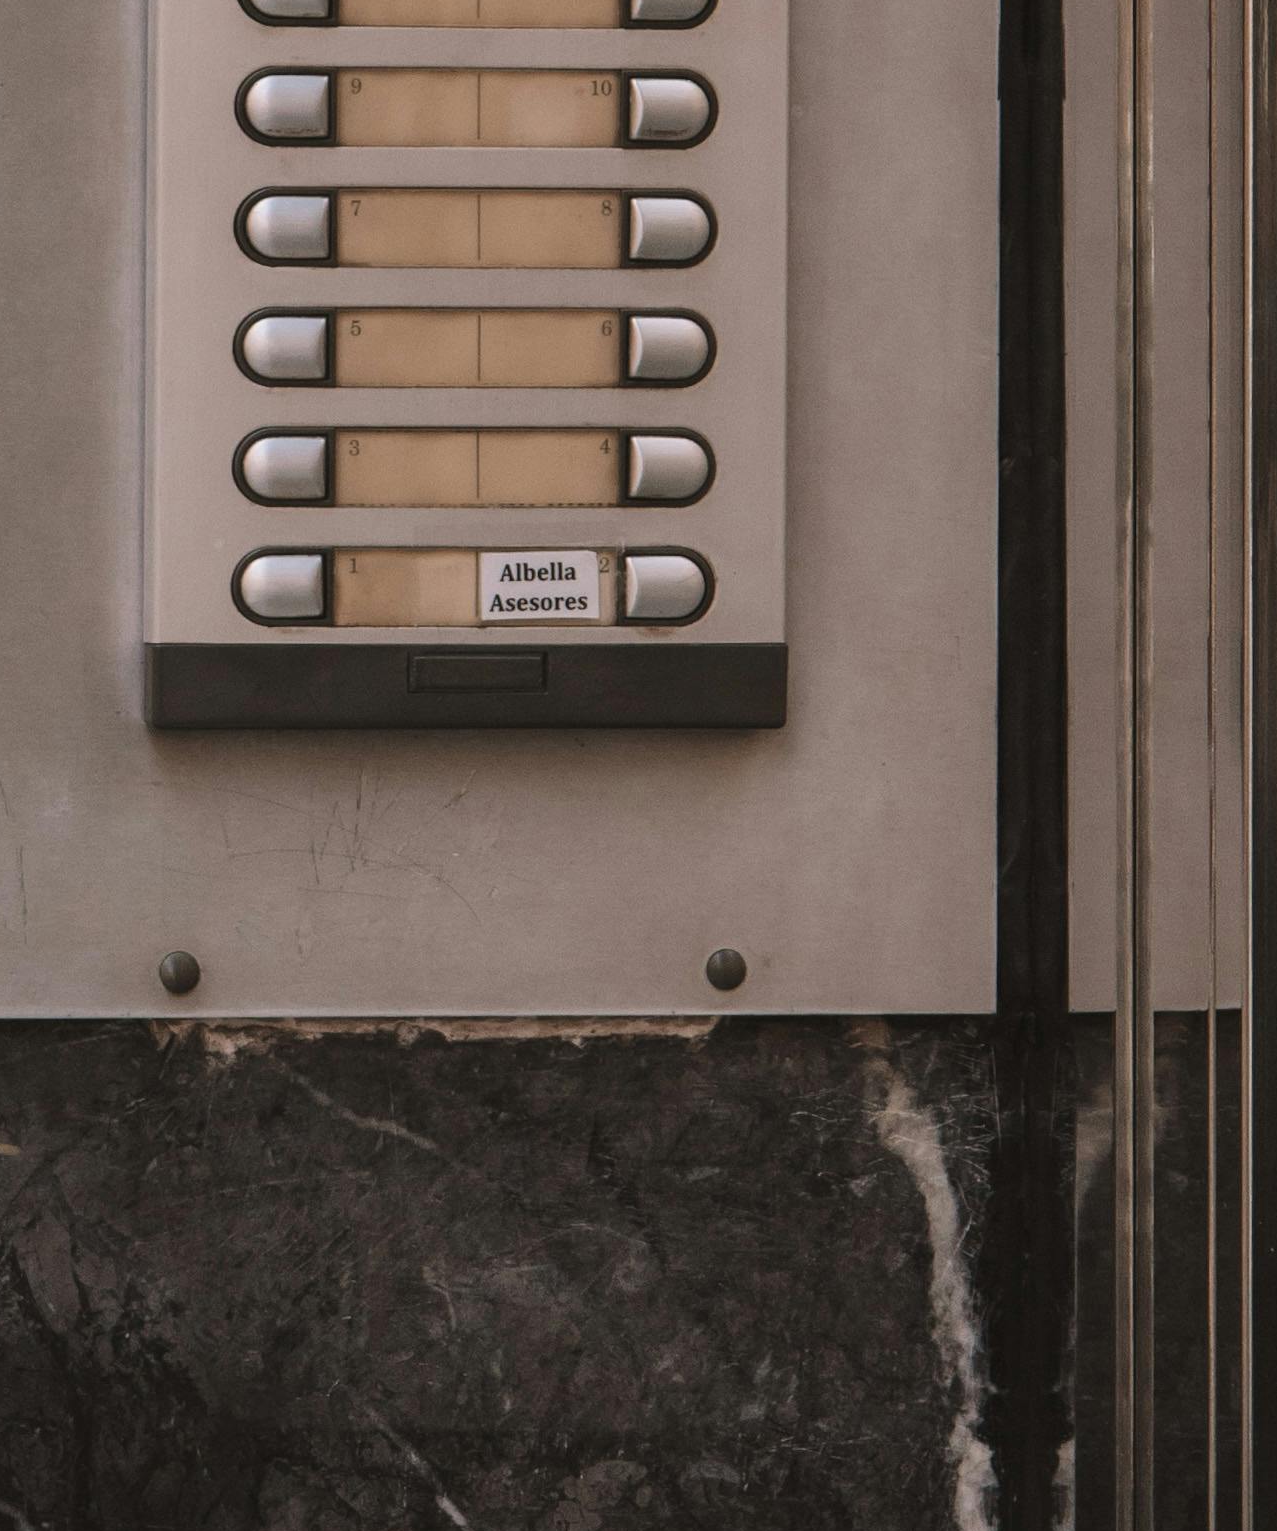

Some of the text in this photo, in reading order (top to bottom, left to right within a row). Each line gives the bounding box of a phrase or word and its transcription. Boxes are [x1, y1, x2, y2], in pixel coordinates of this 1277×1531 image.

[350, 78, 363, 95] 9
[590, 80, 613, 97] 10
[350, 200, 362, 217] 7
[600, 199, 613, 217] 8
[350, 320, 362, 337] 5
[601, 319, 613, 337] 6
[348, 439, 361, 457] 3
[599, 438, 611, 455] 4
[349, 557, 358, 574] 1
[499, 561, 577, 582] Albella
[599, 557, 610, 573] 2
[489, 593, 589, 612] Asesores
